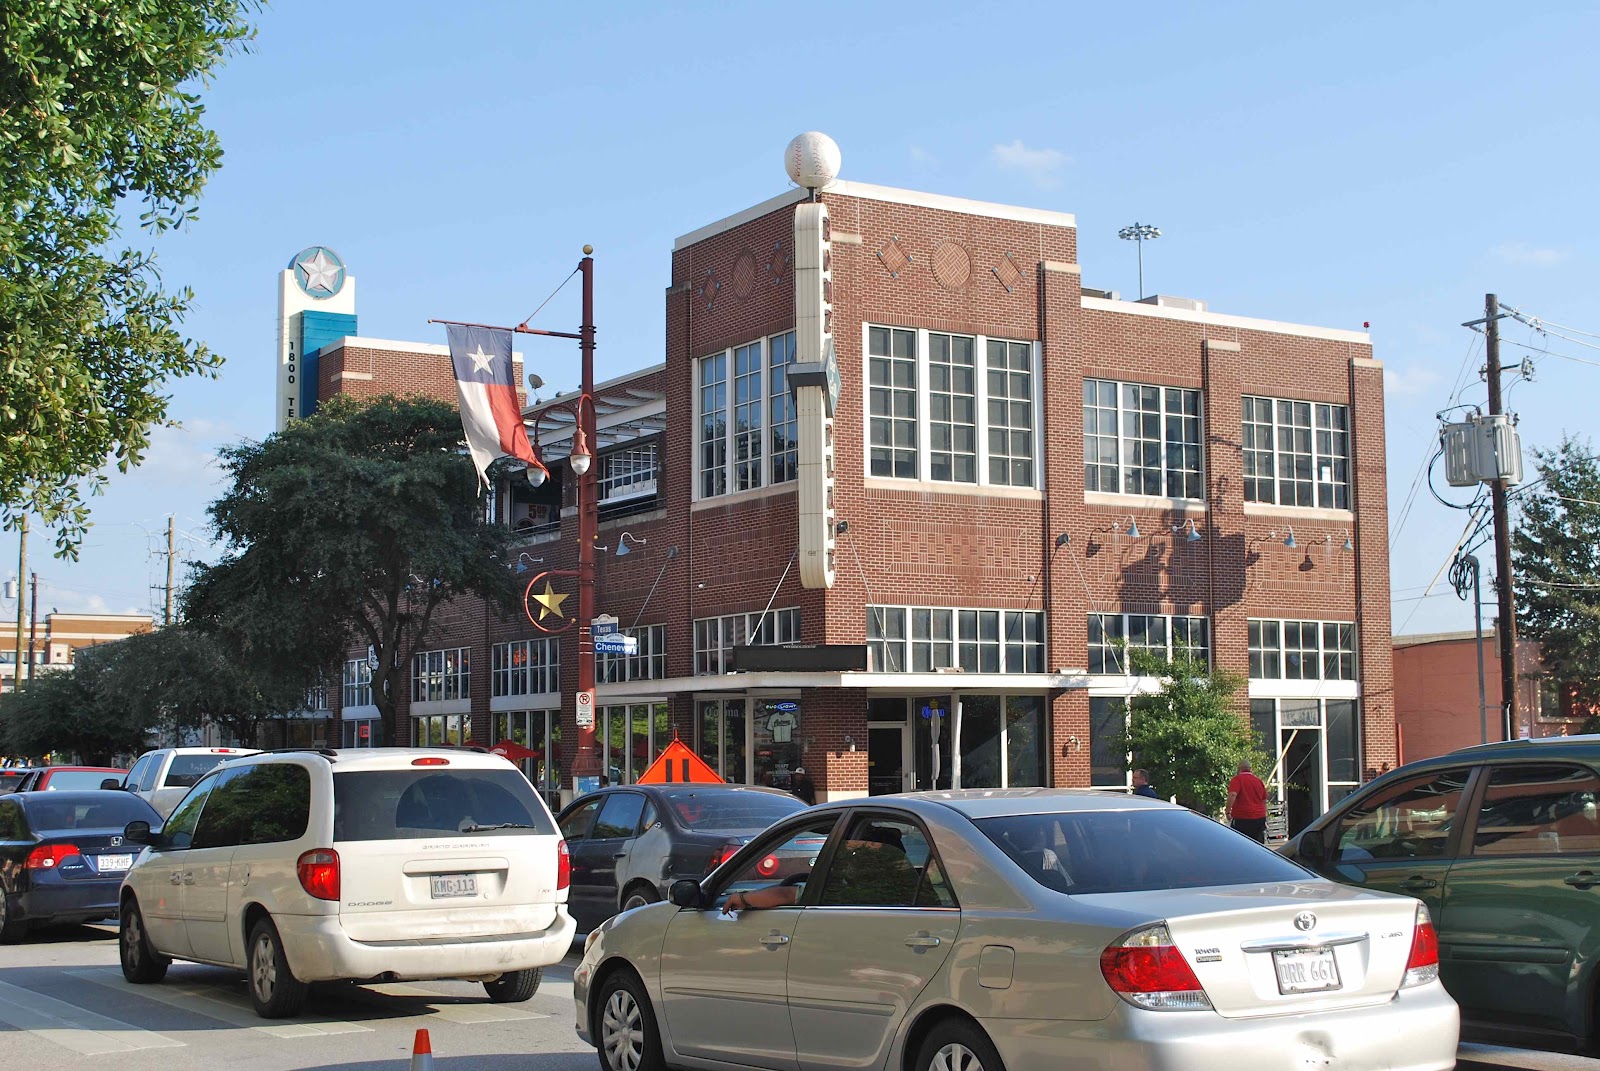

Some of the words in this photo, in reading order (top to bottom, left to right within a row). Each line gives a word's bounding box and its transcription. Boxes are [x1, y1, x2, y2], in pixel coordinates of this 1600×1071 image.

[596, 625, 611, 633] Texas
[704, 706, 739, 718] Coona
[1311, 959, 1334, 981] 667
